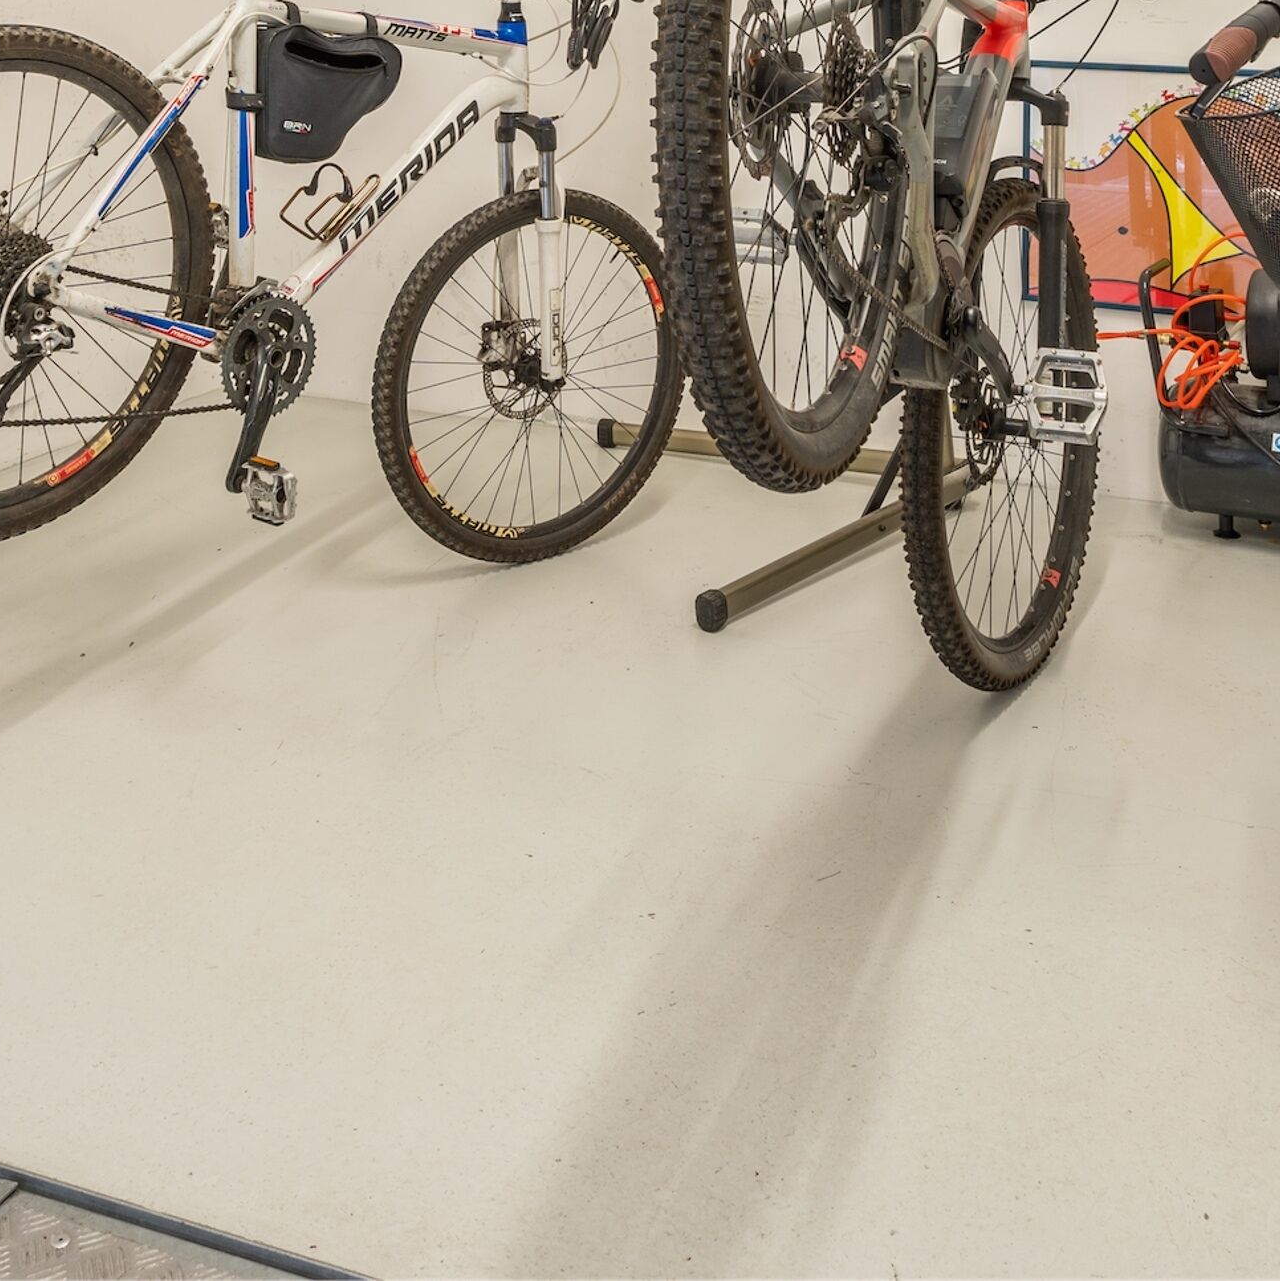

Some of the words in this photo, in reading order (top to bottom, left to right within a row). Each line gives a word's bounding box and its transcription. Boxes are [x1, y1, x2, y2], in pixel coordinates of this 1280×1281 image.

[384, 22, 449, 43] MATTS
[283, 120, 312, 132] BRN
[338, 99, 480, 255] MERIDA
